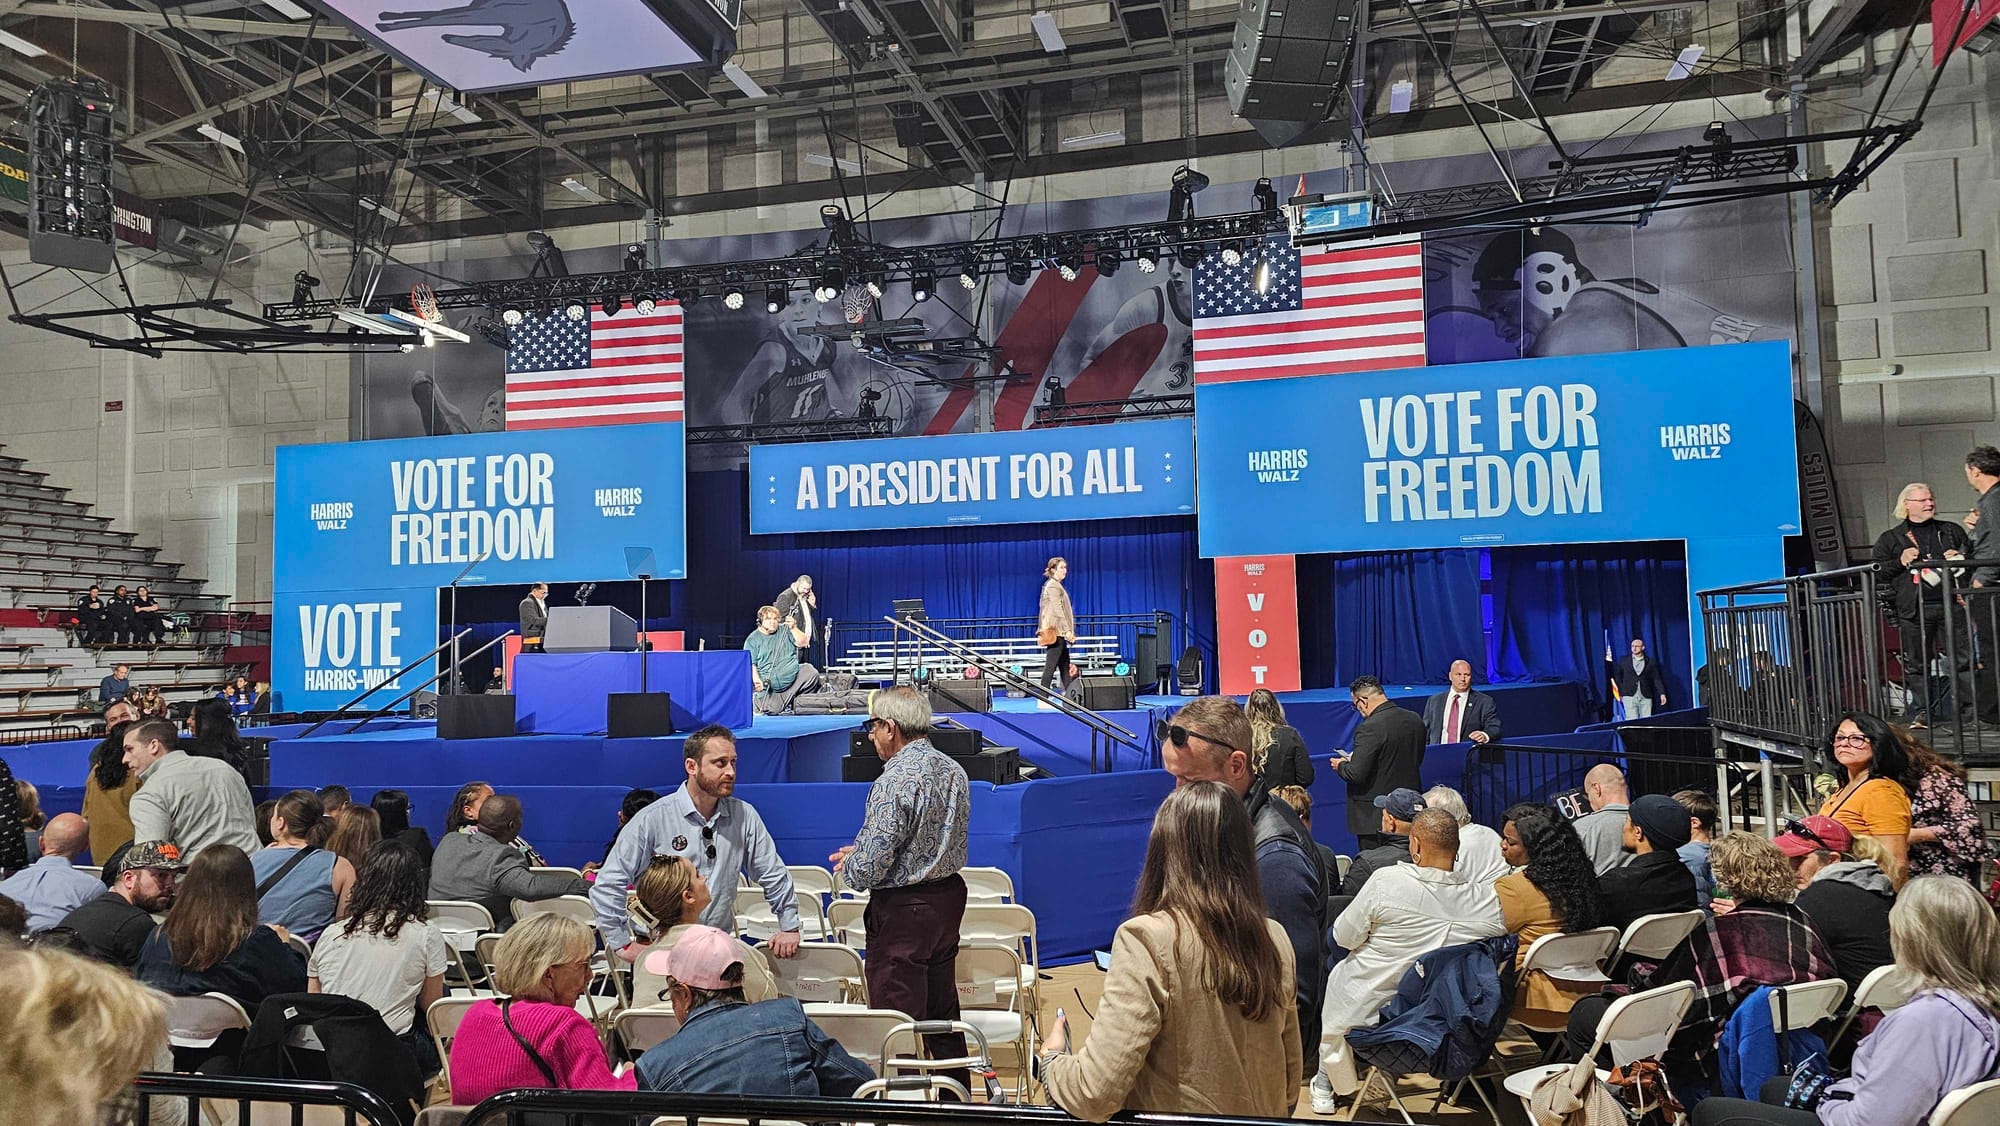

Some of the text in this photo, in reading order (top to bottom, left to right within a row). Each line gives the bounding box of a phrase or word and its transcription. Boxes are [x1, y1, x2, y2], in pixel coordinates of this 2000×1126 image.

[1360, 384, 1600, 459] VOTE FOR
[1660, 423, 1731, 448] HARRIS
[1248, 449, 1308, 471] HARRIS
[1672, 446, 1721, 461] WALZ
[391, 453, 554, 512] VOTE FOR
[796, 446, 1143, 510] A PRESIDENT FOR ALL
[1258, 470, 1300, 483] WALZ
[1363, 449, 1602, 523] FREEDOM
[595, 487, 642, 507] HARRIS
[1802, 452, 1841, 555] GO MULES
[311, 502, 353, 520] HARRIS
[602, 506, 635, 517] WALZ
[317, 520, 347, 531] WALZ
[391, 507, 554, 565] FREEDOM
[299, 602, 401, 668] VOTE
[304, 668, 401, 691] HARRIS-WALZ
[1556, 792, 1589, 819] BE
